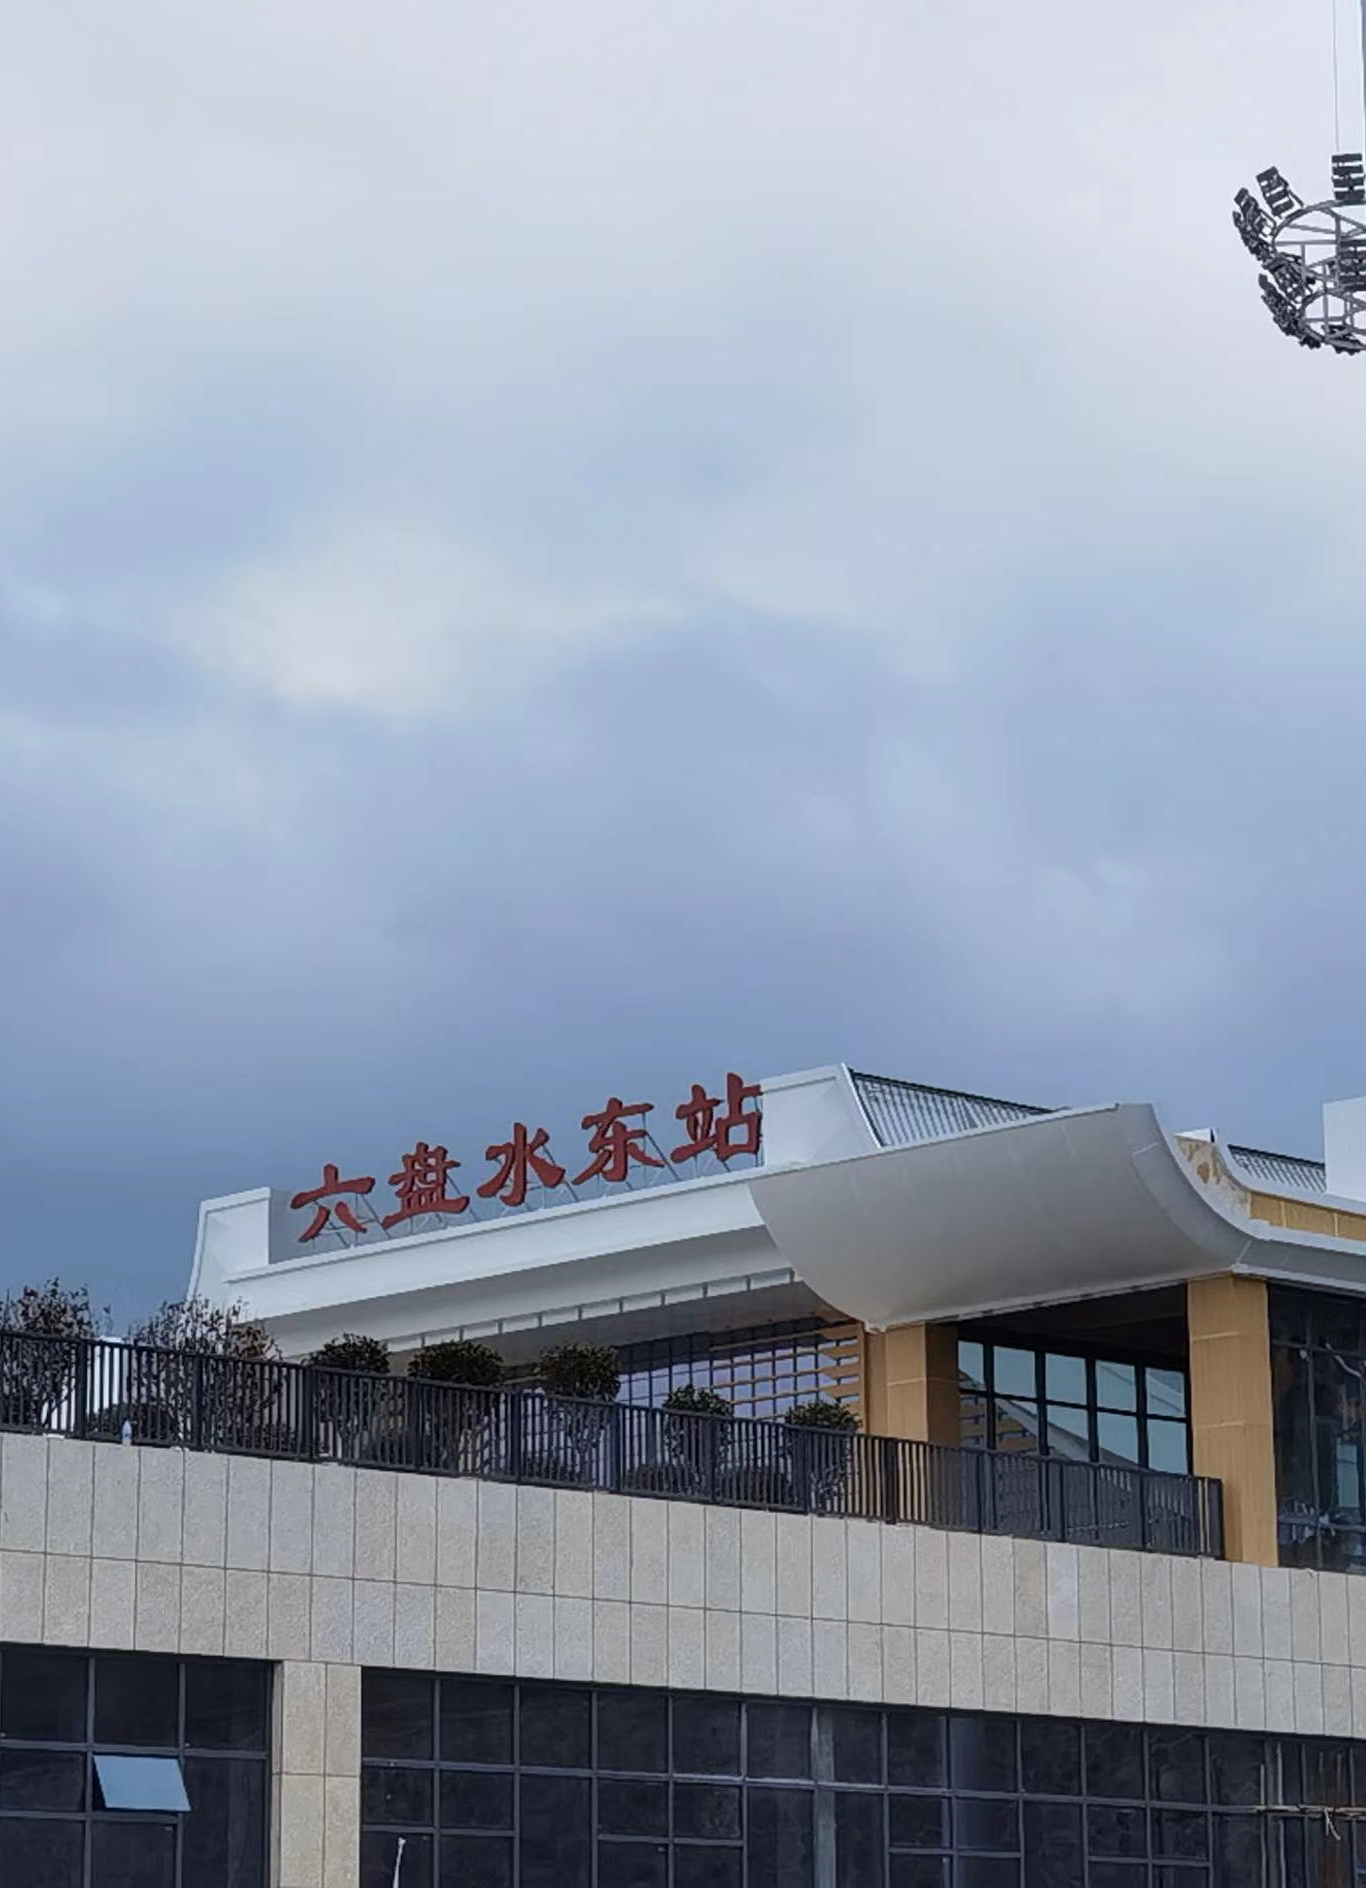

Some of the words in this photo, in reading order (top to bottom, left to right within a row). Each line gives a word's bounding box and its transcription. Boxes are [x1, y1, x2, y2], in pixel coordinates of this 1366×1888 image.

[290, 1072, 763, 1243] 六盘水东站
